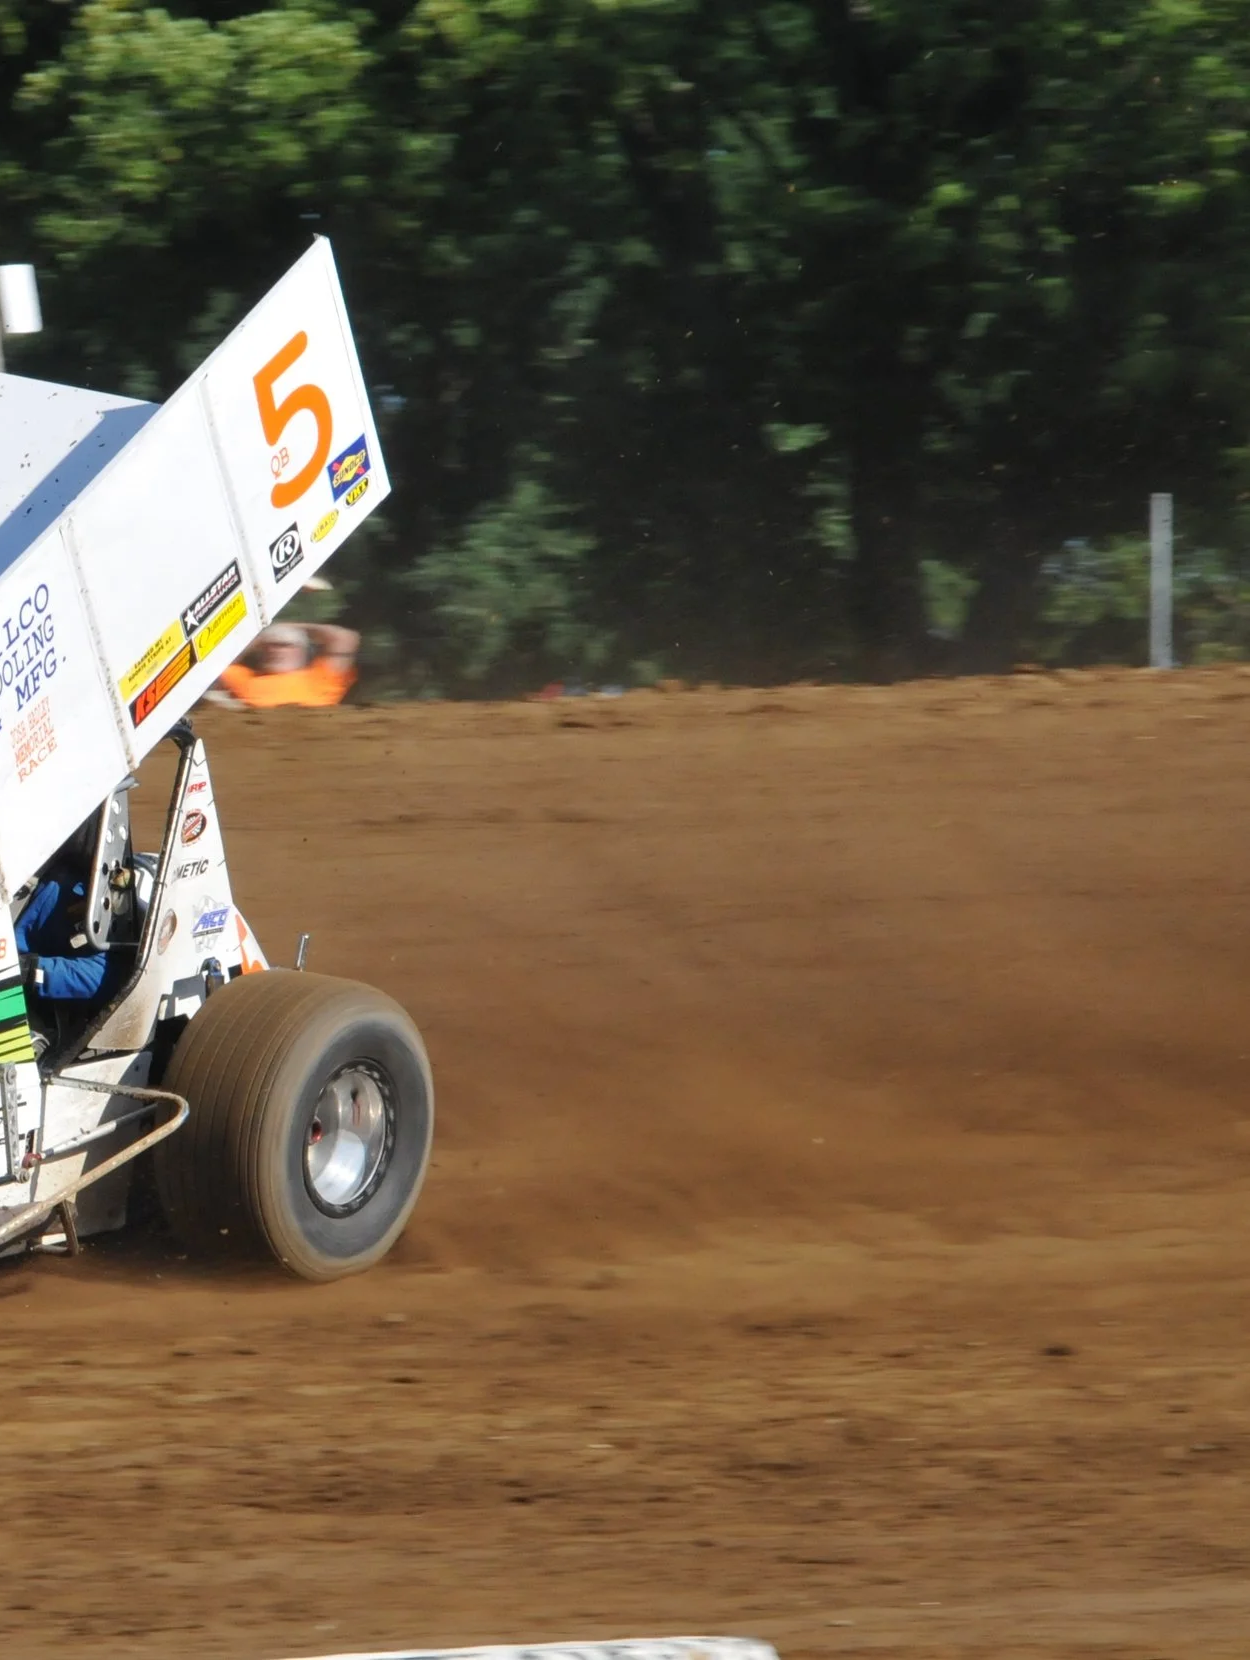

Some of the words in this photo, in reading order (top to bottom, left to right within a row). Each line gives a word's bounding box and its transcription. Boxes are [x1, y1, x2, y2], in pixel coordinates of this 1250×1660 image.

[253, 331, 332, 508] 5
[270, 447, 290, 479] QB
[334, 450, 365, 486] SUNOCO
[194, 564, 236, 615] ALLSTAR
[15, 648, 66, 711] MFG.
